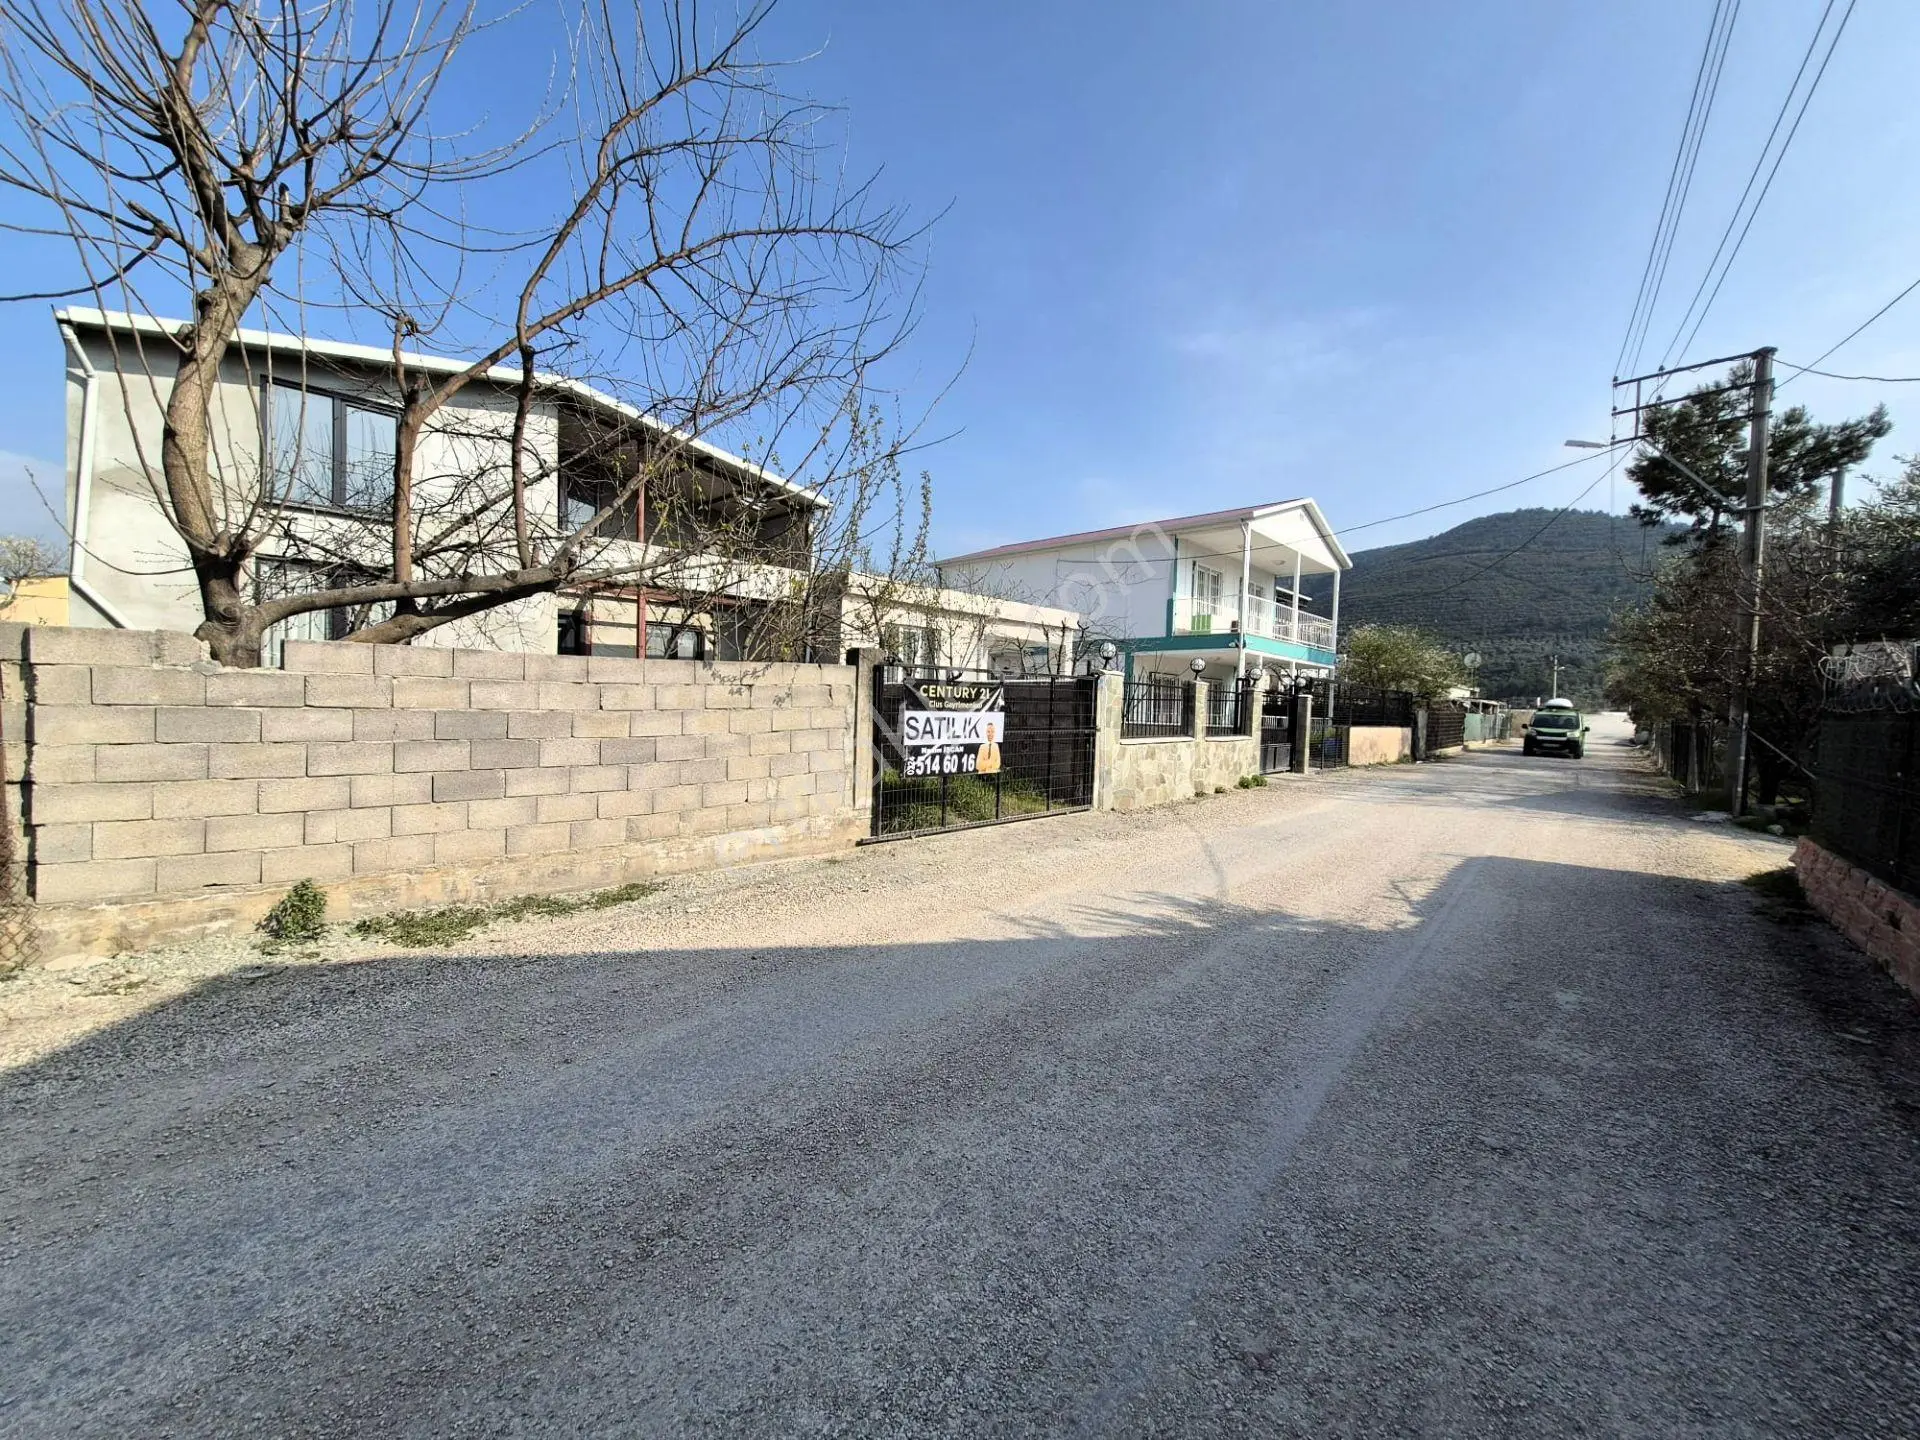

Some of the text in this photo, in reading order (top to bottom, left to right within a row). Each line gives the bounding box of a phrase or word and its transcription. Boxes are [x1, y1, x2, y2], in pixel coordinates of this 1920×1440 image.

[920, 685, 990, 699] CENTURY 21
[905, 716, 982, 740] SATILIK
[915, 755, 940, 775] 514
[943, 754, 959, 773] 60
[962, 754, 976, 772] 16
